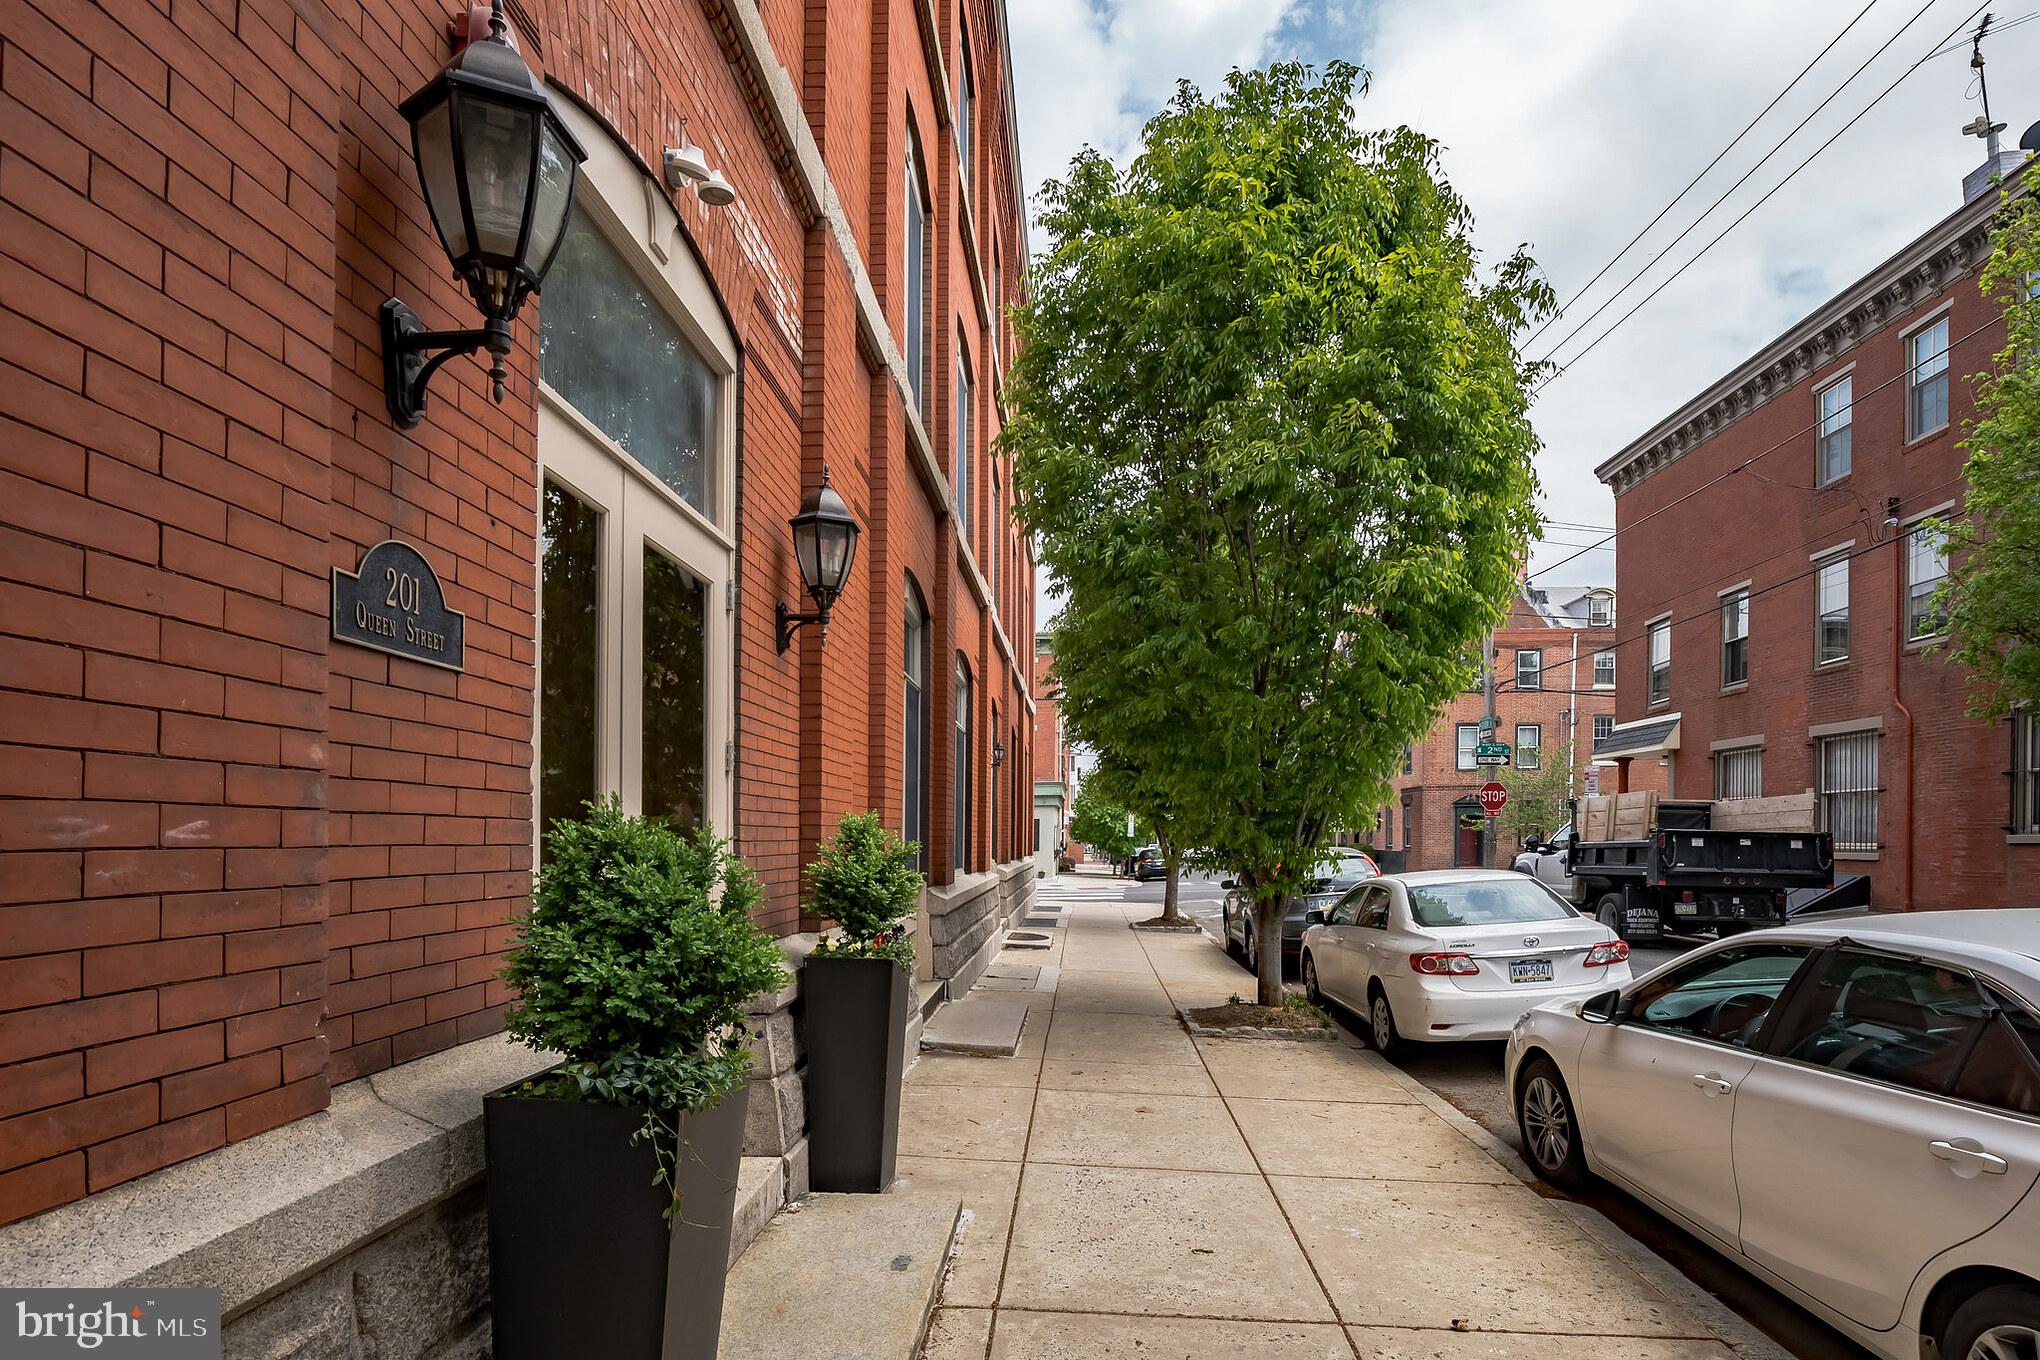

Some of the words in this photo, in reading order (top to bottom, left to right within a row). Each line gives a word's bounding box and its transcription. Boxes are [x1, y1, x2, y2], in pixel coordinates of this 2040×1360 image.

[386, 567, 420, 615] 201
[356, 600, 397, 637] QUEEN
[405, 617, 445, 651] STREET
[1481, 790, 1506, 802] STOP
[1626, 907, 1659, 918] DEJANA
